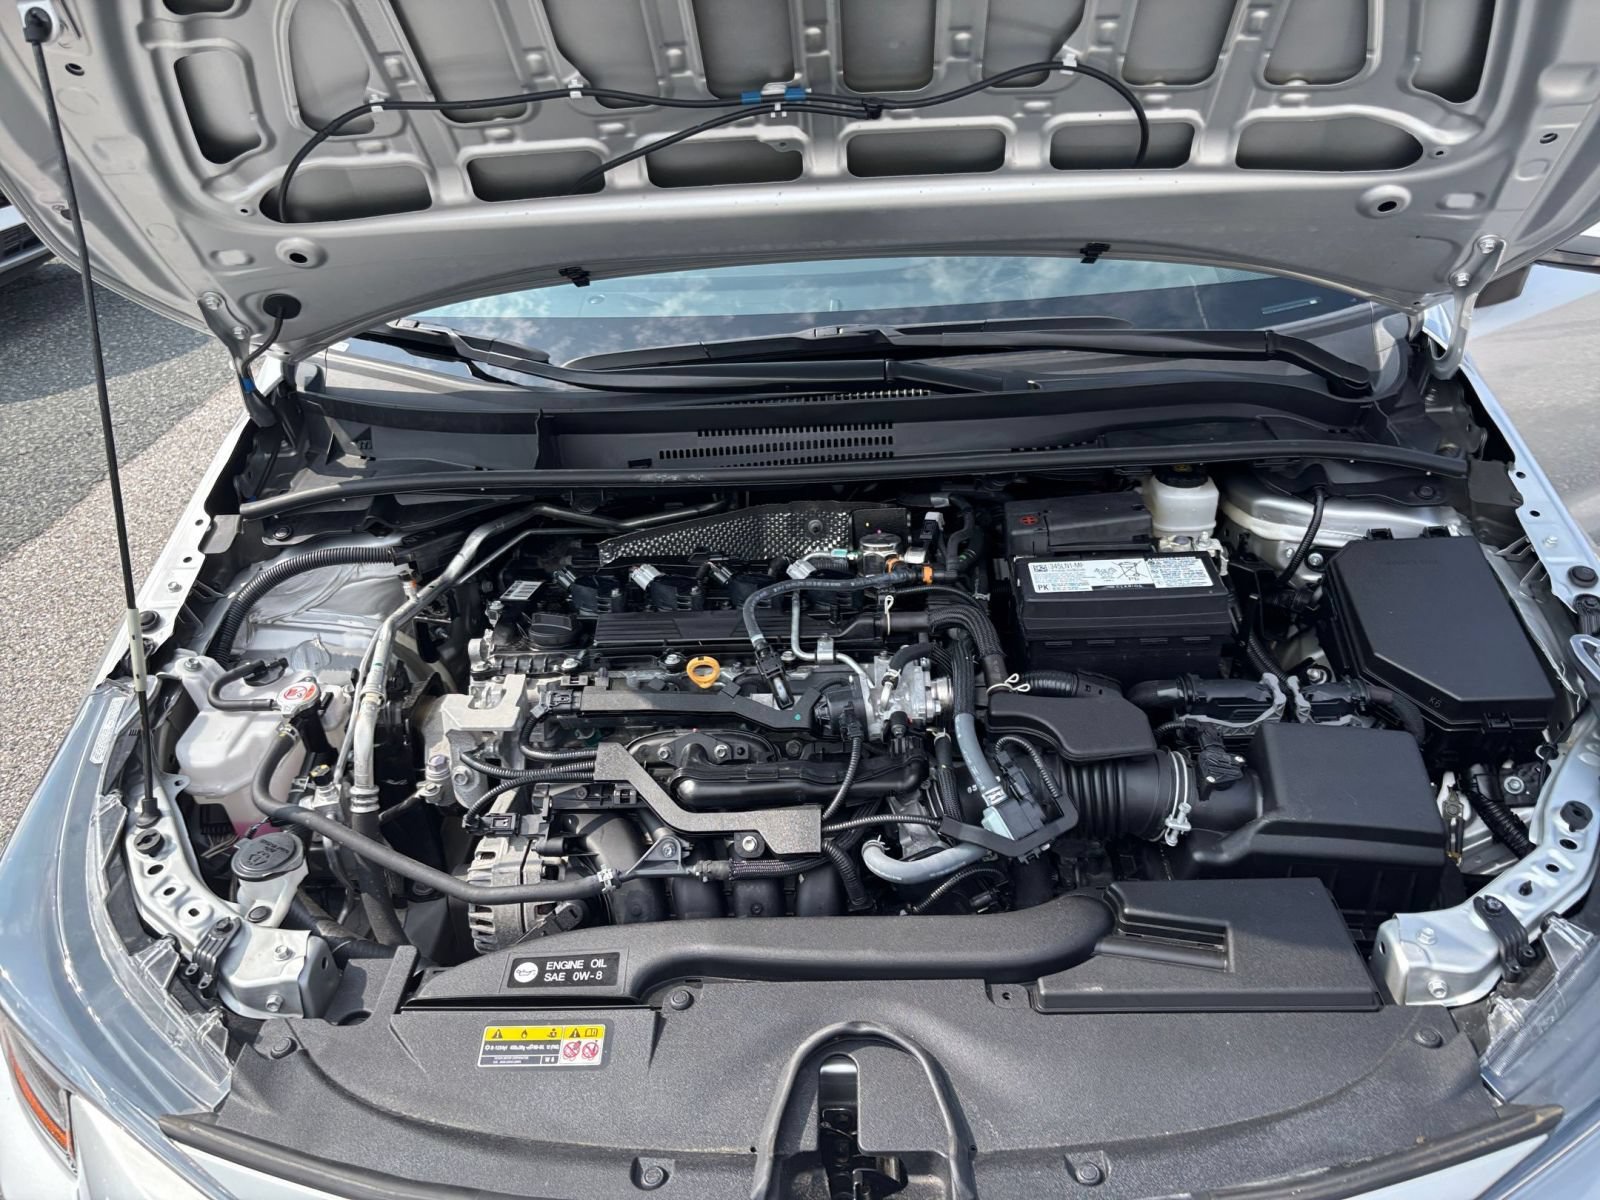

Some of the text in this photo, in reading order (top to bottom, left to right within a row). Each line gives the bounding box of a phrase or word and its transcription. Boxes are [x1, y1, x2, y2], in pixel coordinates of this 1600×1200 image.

[1037, 584, 1050, 592] PK
[545, 958, 608, 971] ENGINE OIL
[543, 970, 603, 982] SAE 0W-8
